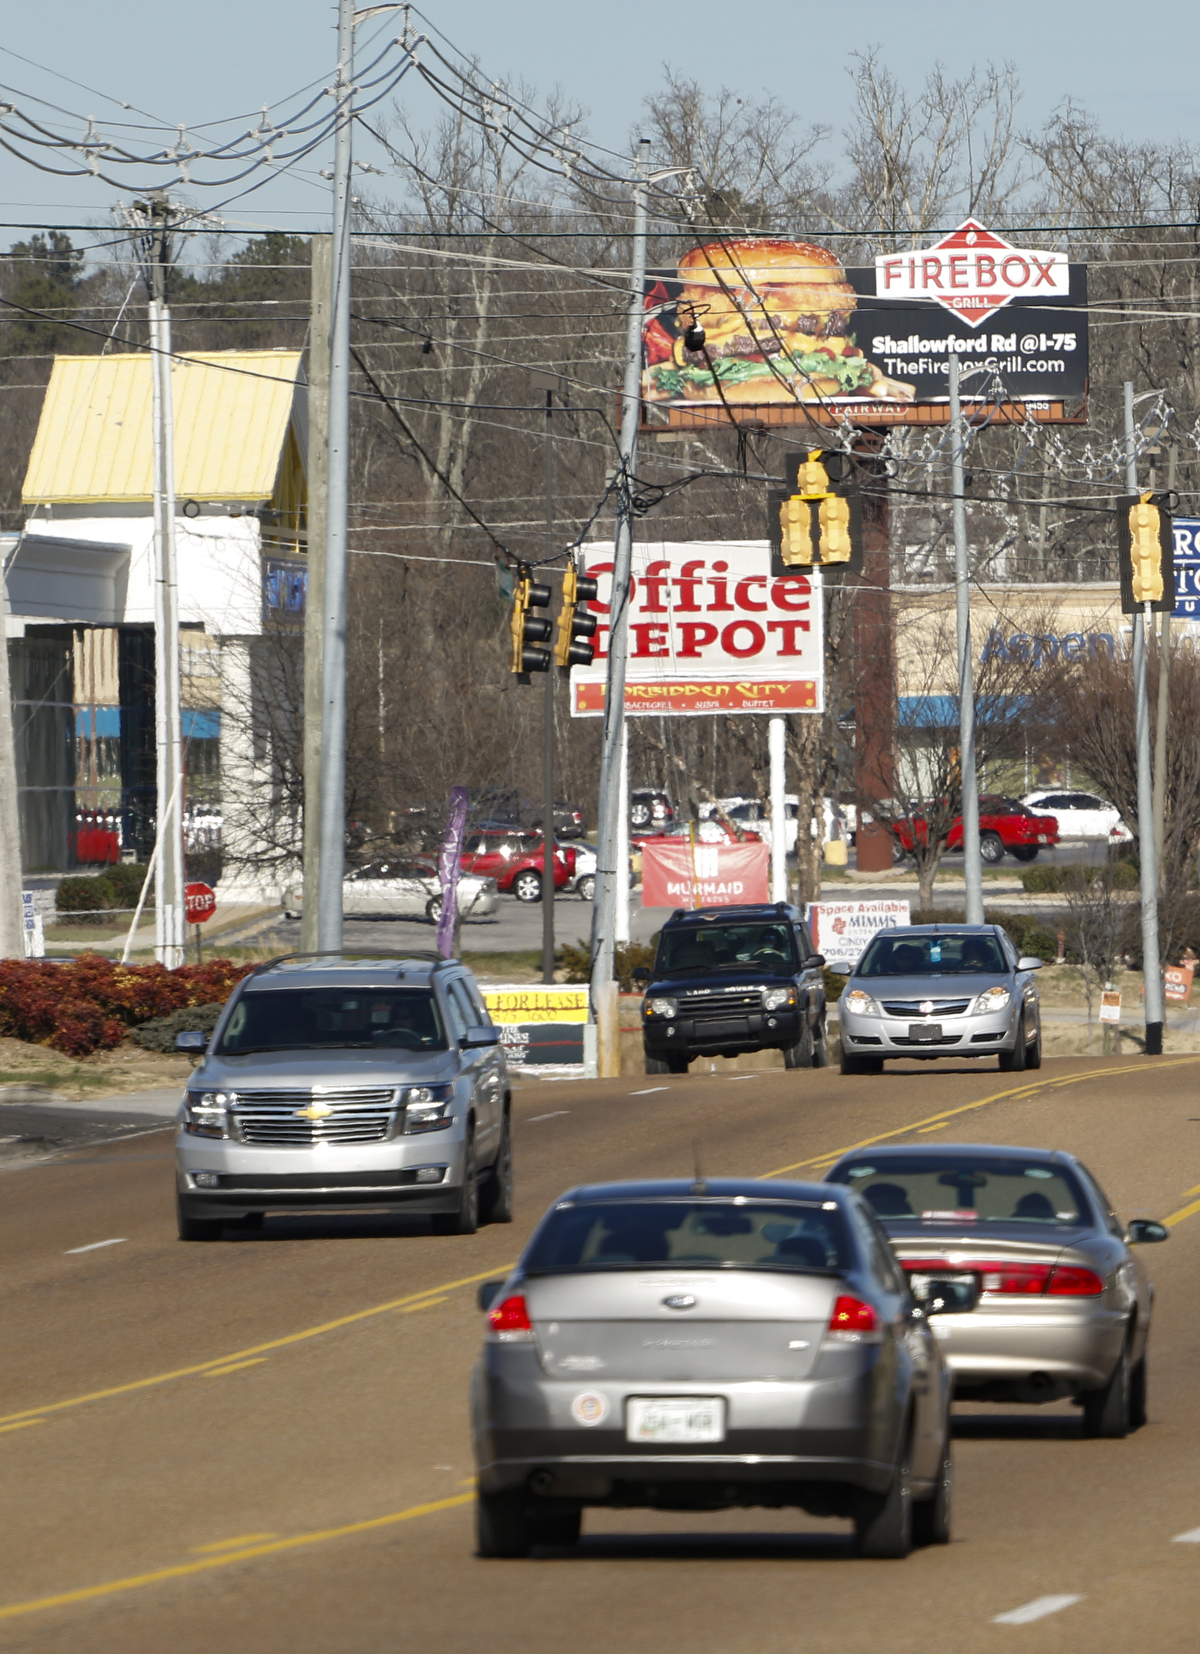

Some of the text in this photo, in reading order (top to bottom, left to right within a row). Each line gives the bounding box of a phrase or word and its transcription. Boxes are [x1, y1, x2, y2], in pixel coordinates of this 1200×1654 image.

[883, 253, 1057, 289] FIREBOX
[952, 297, 991, 309] GRILL
[871, 332, 1077, 354] Shallowford Rd @I-75
[884, 355, 1065, 375] TheFireoxGrill.com
[835, 404, 901, 414] FAIRWAY
[585, 560, 810, 614] Office
[980, 618, 1115, 669] Aspen
[735, 682, 791, 698] CITY
[184, 894, 215, 911] TOP
[820, 902, 908, 916] Space Available
[849, 914, 897, 928] MIMMS
[823, 947, 863, 957] 706/27
[497, 993, 529, 1010] FOR
[535, 992, 585, 1010] LEASE
